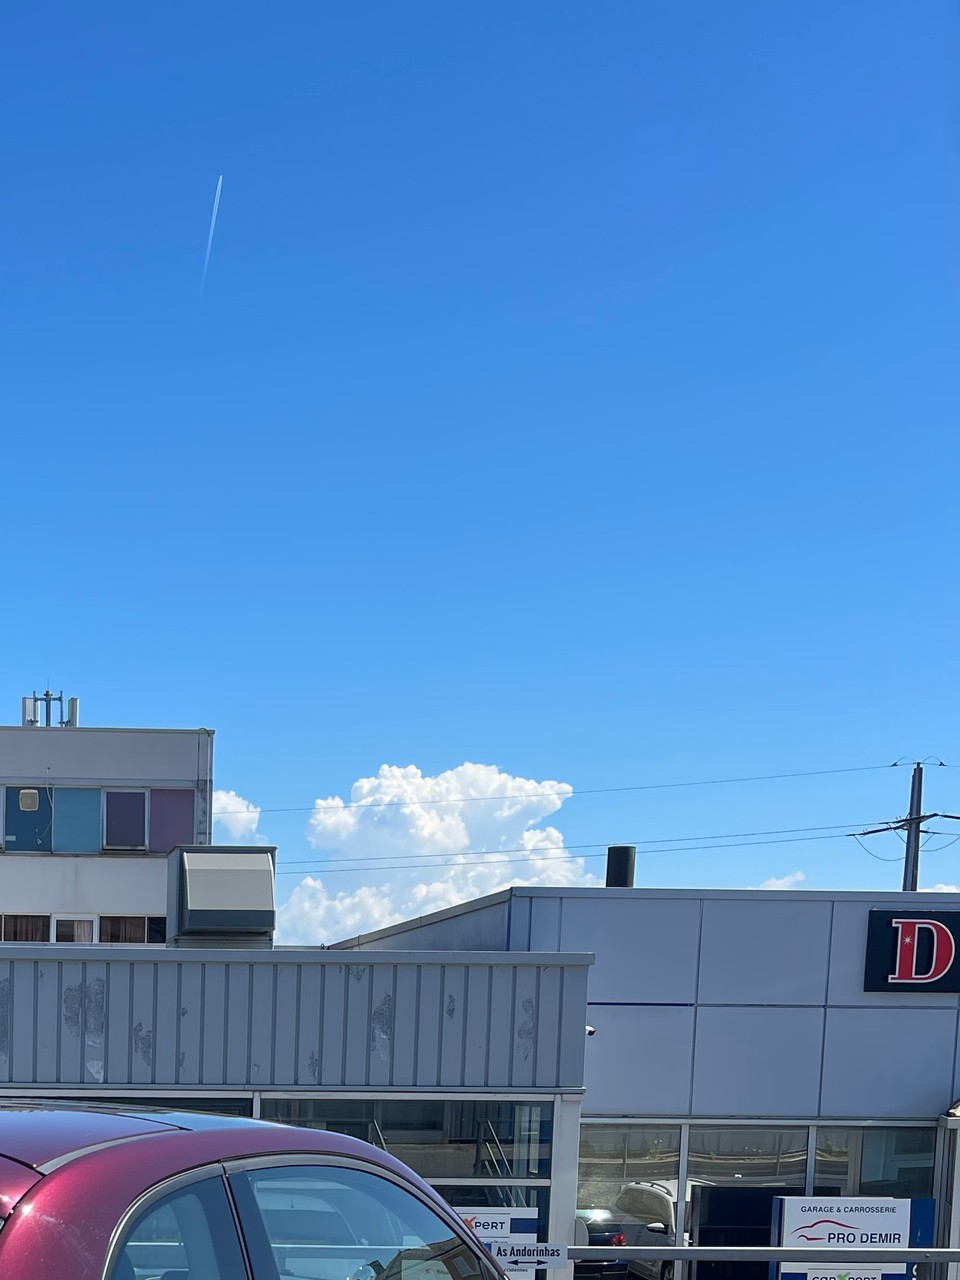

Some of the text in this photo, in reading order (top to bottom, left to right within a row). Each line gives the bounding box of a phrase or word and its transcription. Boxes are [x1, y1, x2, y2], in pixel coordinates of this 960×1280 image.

[800, 1205, 835, 1213] GARAGE
[843, 1206, 897, 1214] CARROSSERIE
[827, 1232, 902, 1244] PRO DEMIR
[496, 1246, 560, 1257] As Andorinhas
